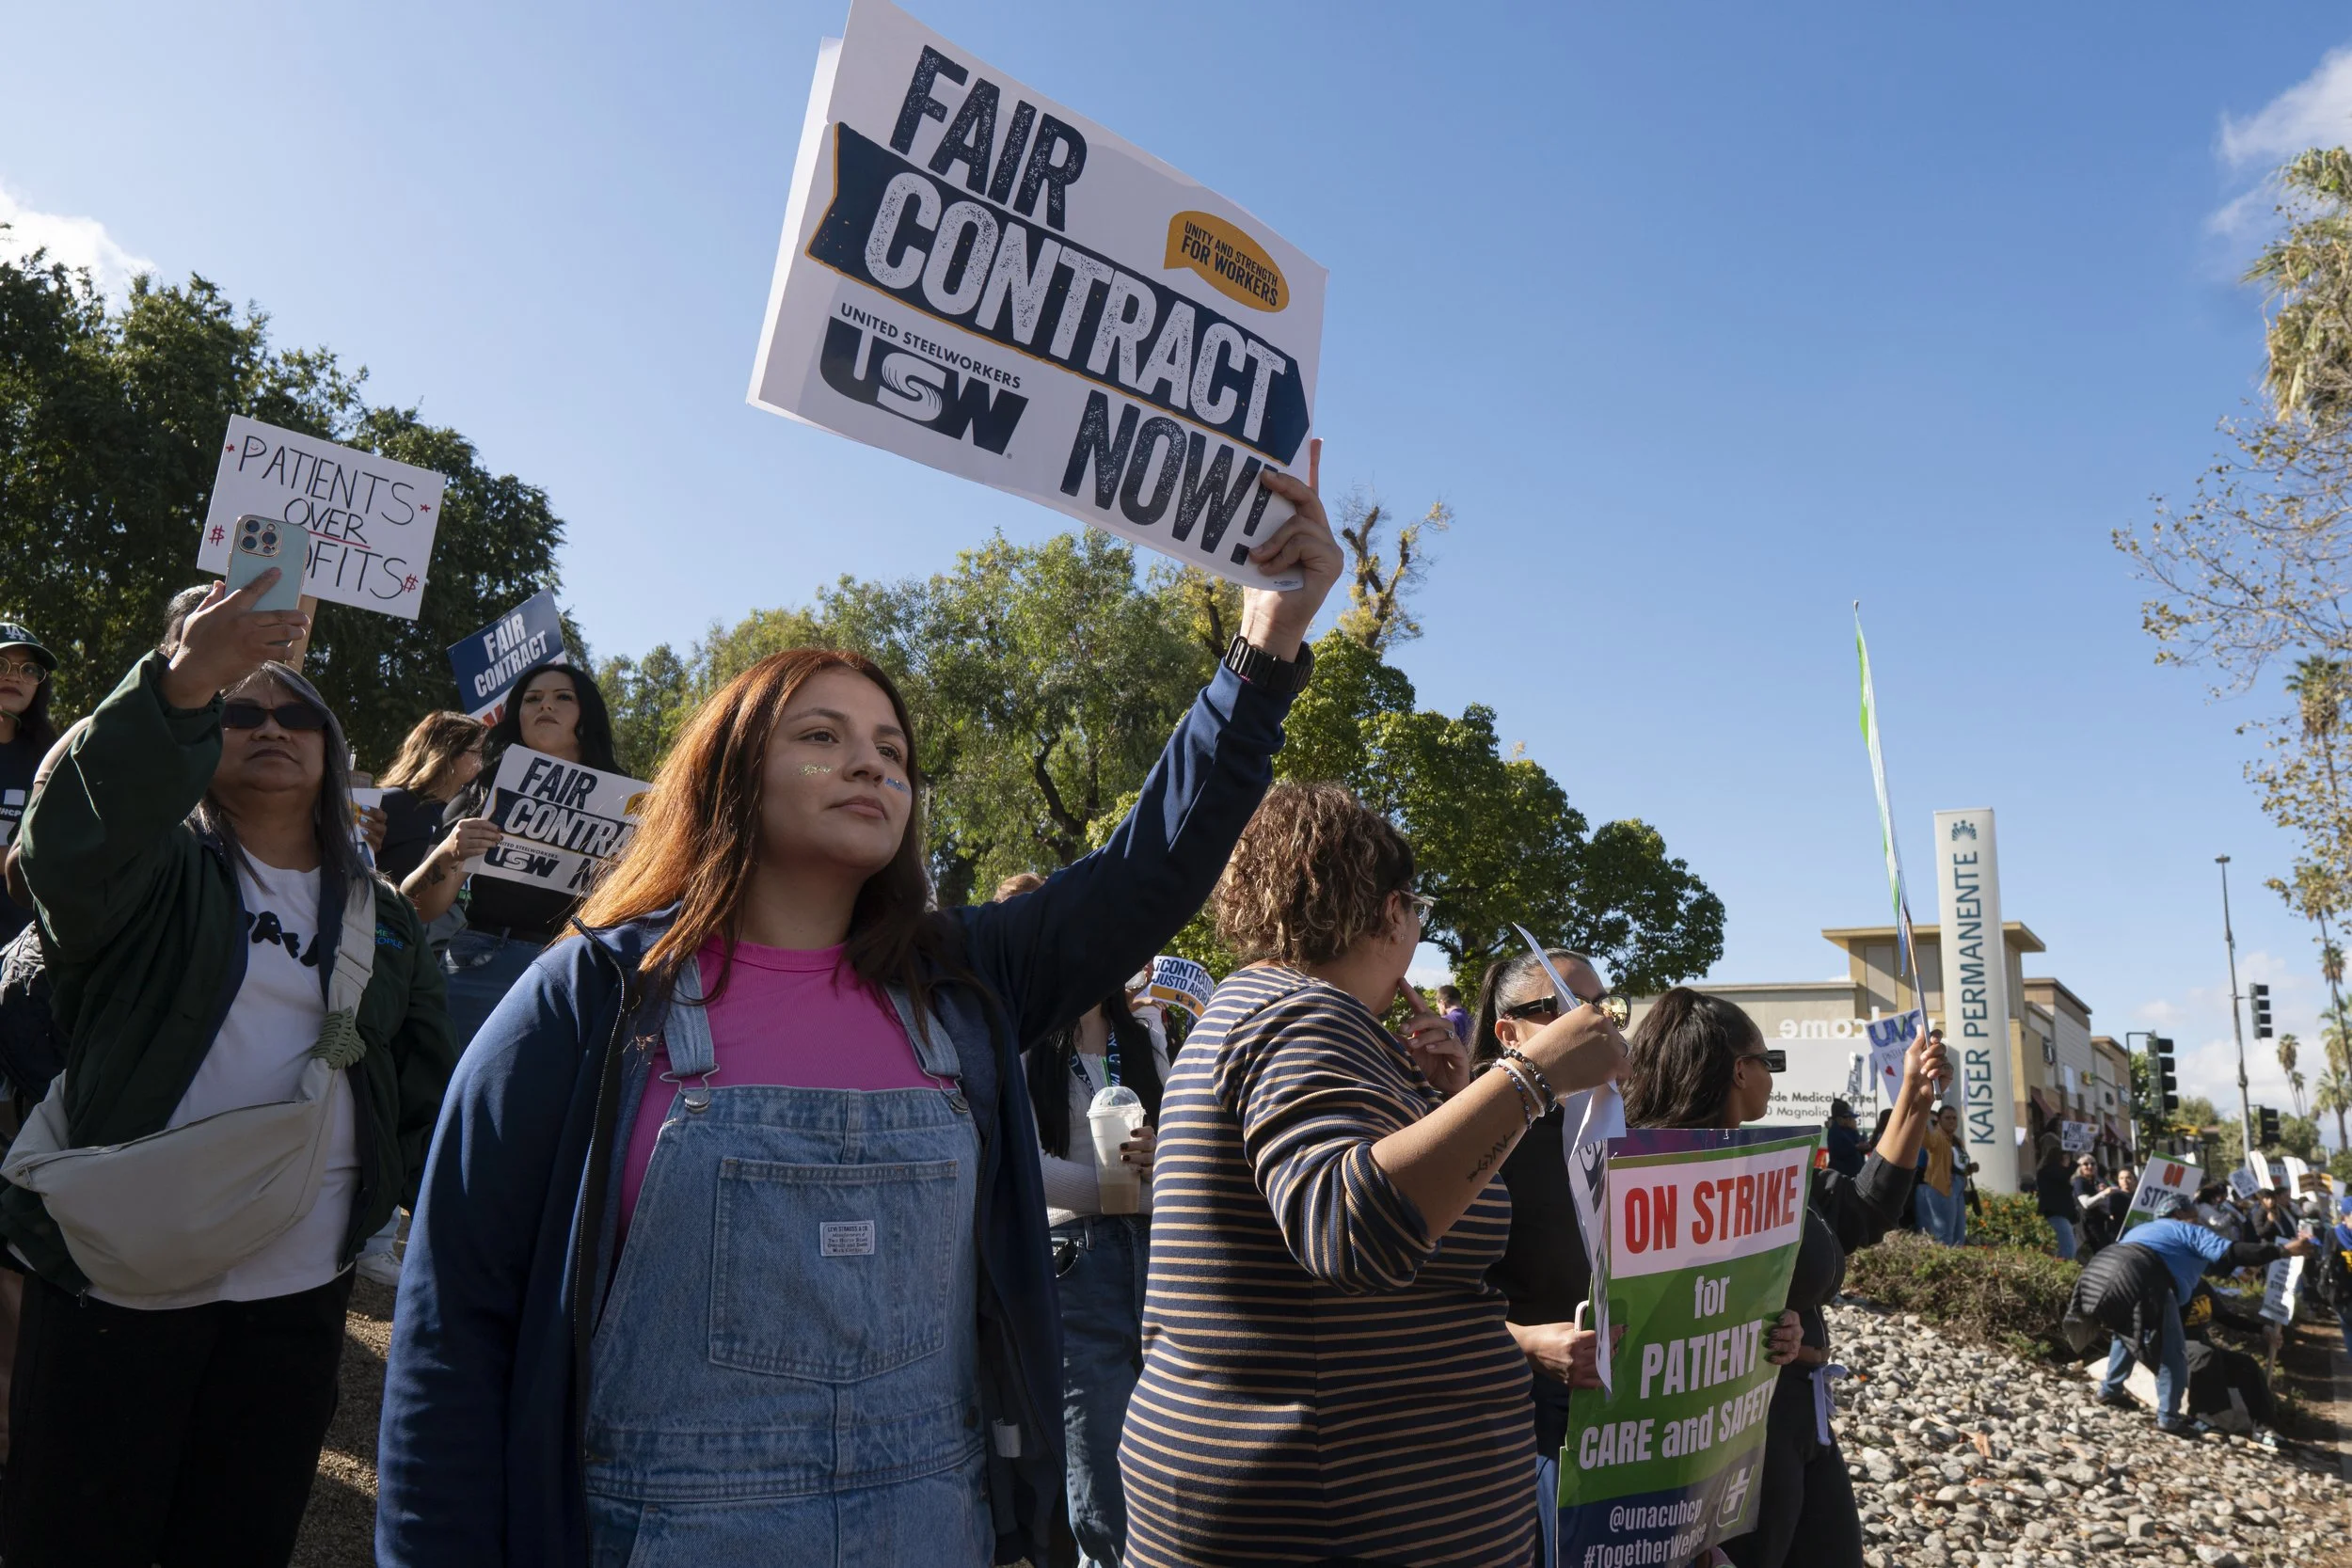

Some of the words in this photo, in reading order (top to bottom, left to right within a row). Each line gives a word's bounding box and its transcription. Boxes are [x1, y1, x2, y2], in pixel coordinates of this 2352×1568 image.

[889, 44, 1089, 232] FAIR
[1182, 234, 1211, 265] FOR
[1215, 252, 1279, 307] WORKERS
[1184, 220, 1214, 245] UNITY
[1215, 239, 1233, 259] AND
[1235, 251, 1278, 287] STRENGTH
[865, 171, 1287, 444] CONTRACT
[840, 302, 898, 339] UNITED
[902, 332, 1022, 389] STEELWORKERS
[819, 316, 1029, 456] USW
[238, 435, 415, 526] PATIENTS
[1059, 389, 1279, 566] NOW!
[284, 498, 368, 545] OVER
[306, 540, 405, 599] FITS
[5, 625, 26, 641] LA
[473, 630, 548, 698] CONTRACT
[483, 612, 527, 663] FAIR
[0, 807, 22, 816] HCP
[517, 757, 597, 810] FAIR
[503, 798, 637, 858] CONTRA
[516, 843, 558, 859] STEELWORKERS
[484, 847, 560, 879] USW
[1953, 850, 1989, 1038] PERMANENTE
[1152, 973, 1188, 990] JUSTO
[1776, 1105, 1829, 1119] Magnolia
[1791, 1091, 1835, 1103] Medical
[1965, 1049, 1995, 1145] KAISER
[1625, 1185, 1677, 1254] ON
[1692, 1164, 1799, 1245] STRIKE
[1694, 1275, 1730, 1319] for
[1640, 1319, 1762, 1400] PATIENT
[1579, 1418, 1655, 1470] CARE
[1661, 1405, 1714, 1459] and
[1610, 1497, 1703, 1532] @unacuhcp
